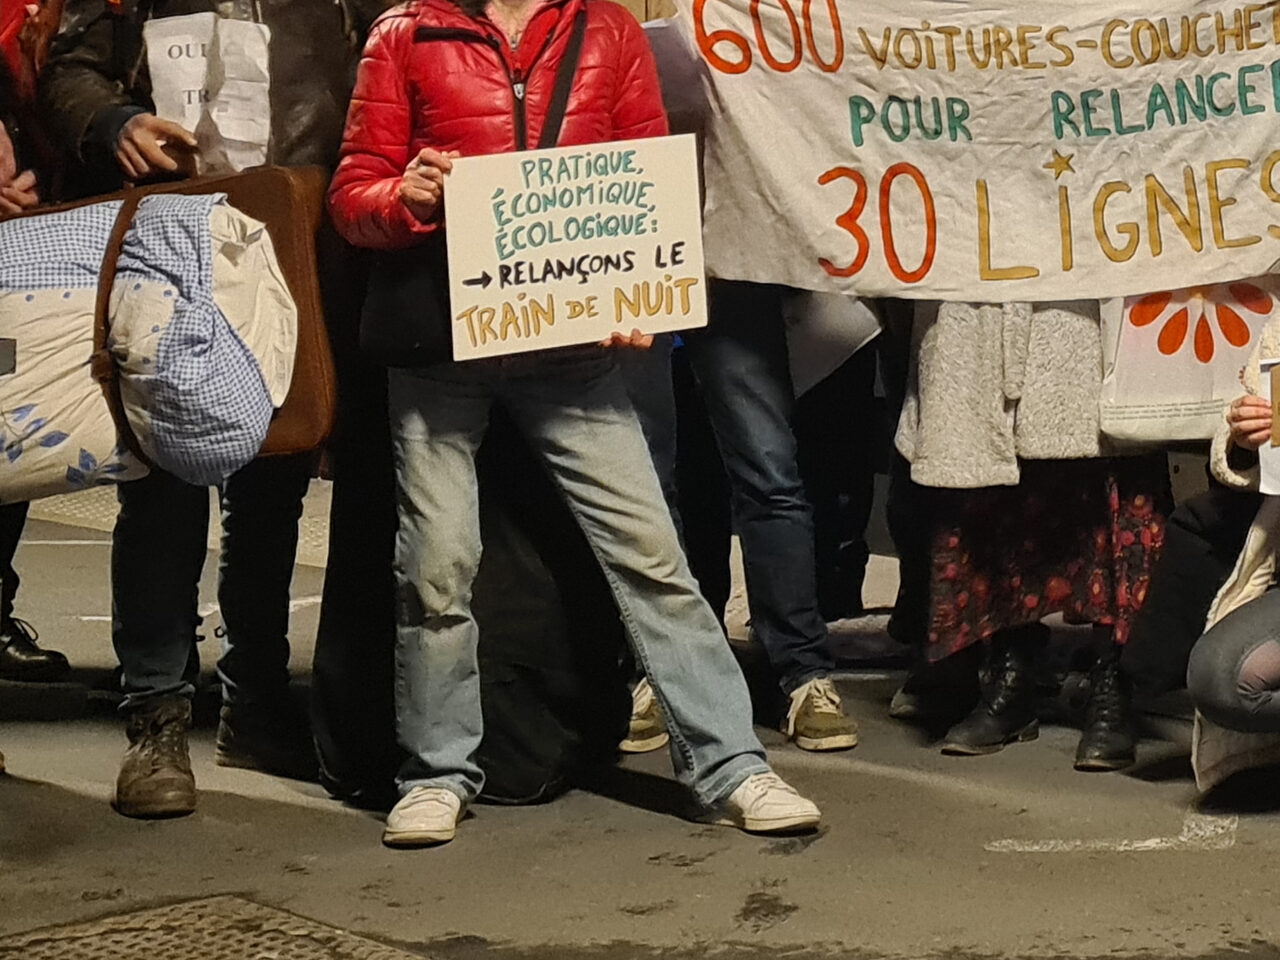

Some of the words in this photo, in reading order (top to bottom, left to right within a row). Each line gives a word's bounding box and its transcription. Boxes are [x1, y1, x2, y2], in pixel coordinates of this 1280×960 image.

[849, 95, 973, 147] POUR
[817, 162, 937, 283] 30
[499, 250, 636, 289] RELANÇONS
[655, 241, 686, 268] LE
[565, 295, 600, 320] DE
